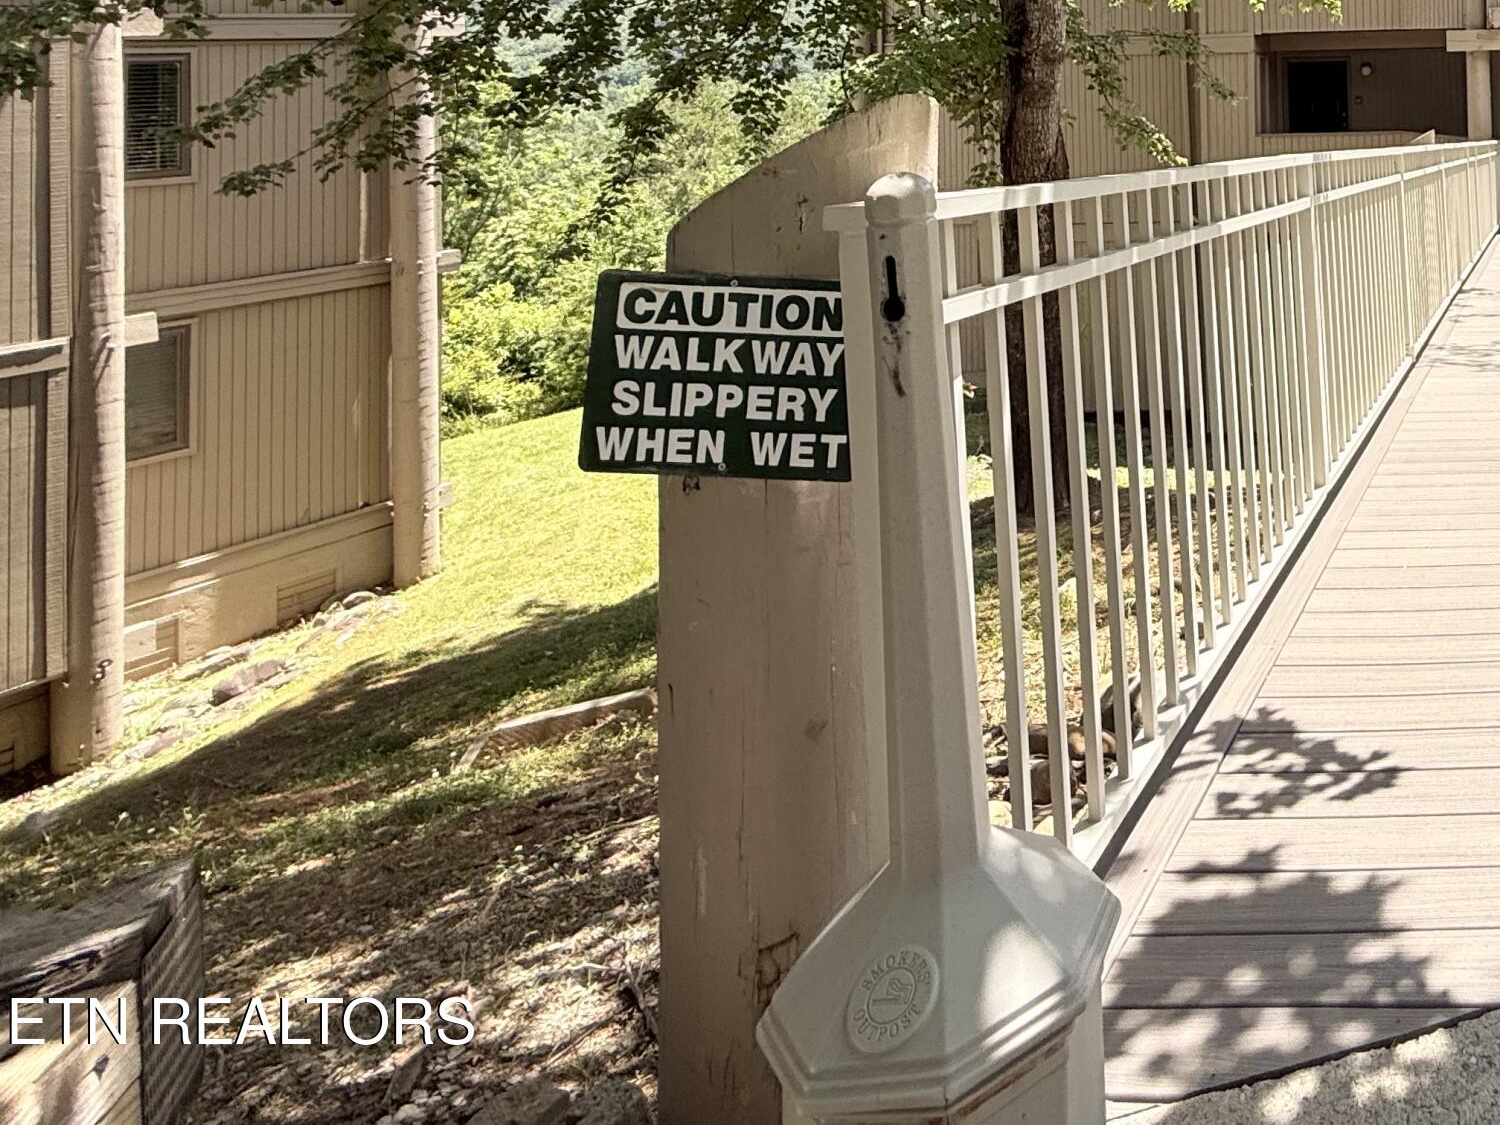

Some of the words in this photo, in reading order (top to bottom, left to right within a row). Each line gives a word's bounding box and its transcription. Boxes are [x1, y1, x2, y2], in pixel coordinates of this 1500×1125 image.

[623, 287, 844, 332] CAUTION
[611, 379, 838, 422] SLIPPERY
[596, 426, 725, 464] WHEN
[750, 431, 847, 468] WET
[853, 1004, 921, 1041] OUTPOST
